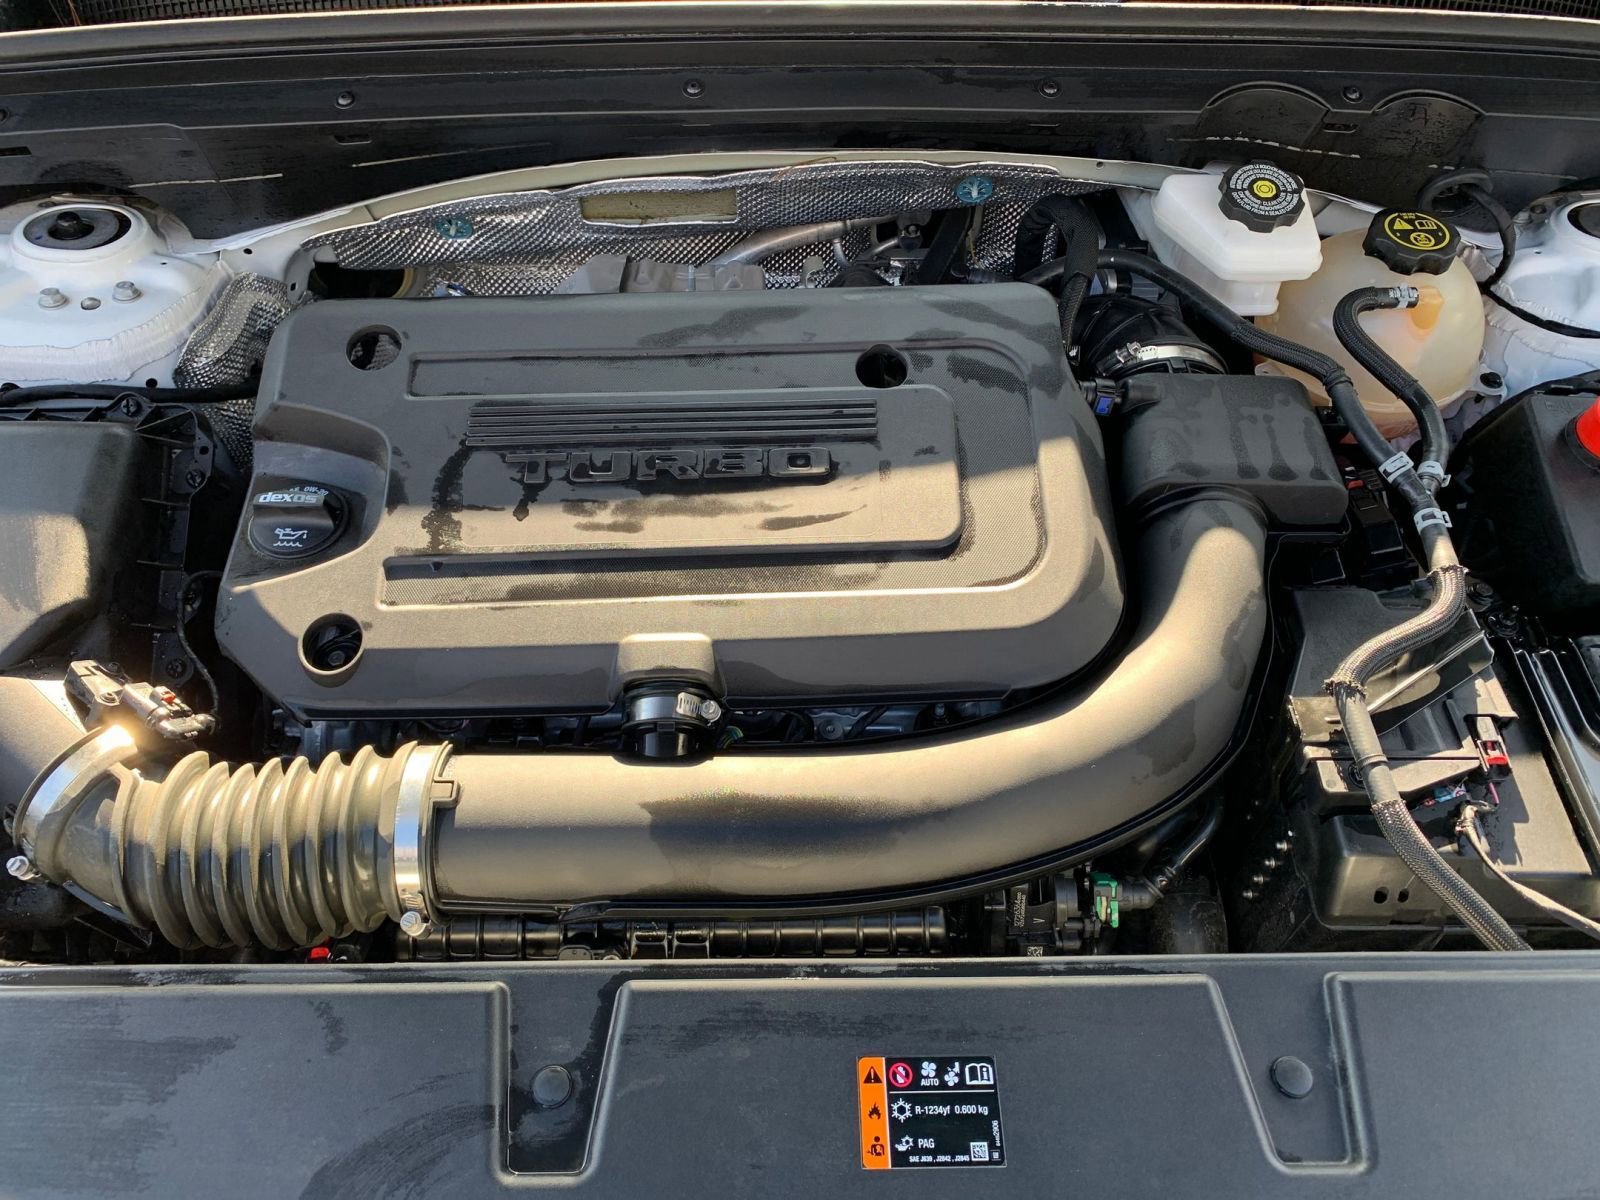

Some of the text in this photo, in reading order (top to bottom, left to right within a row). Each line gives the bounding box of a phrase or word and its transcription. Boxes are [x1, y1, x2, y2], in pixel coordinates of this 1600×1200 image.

[505, 448, 831, 484] TURBO
[258, 492, 317, 504] dexos
[920, 1078, 940, 1086] AUTO
[915, 1105, 988, 1116] R-1234yf 0.600 kg
[918, 1138, 935, 1149] PAG
